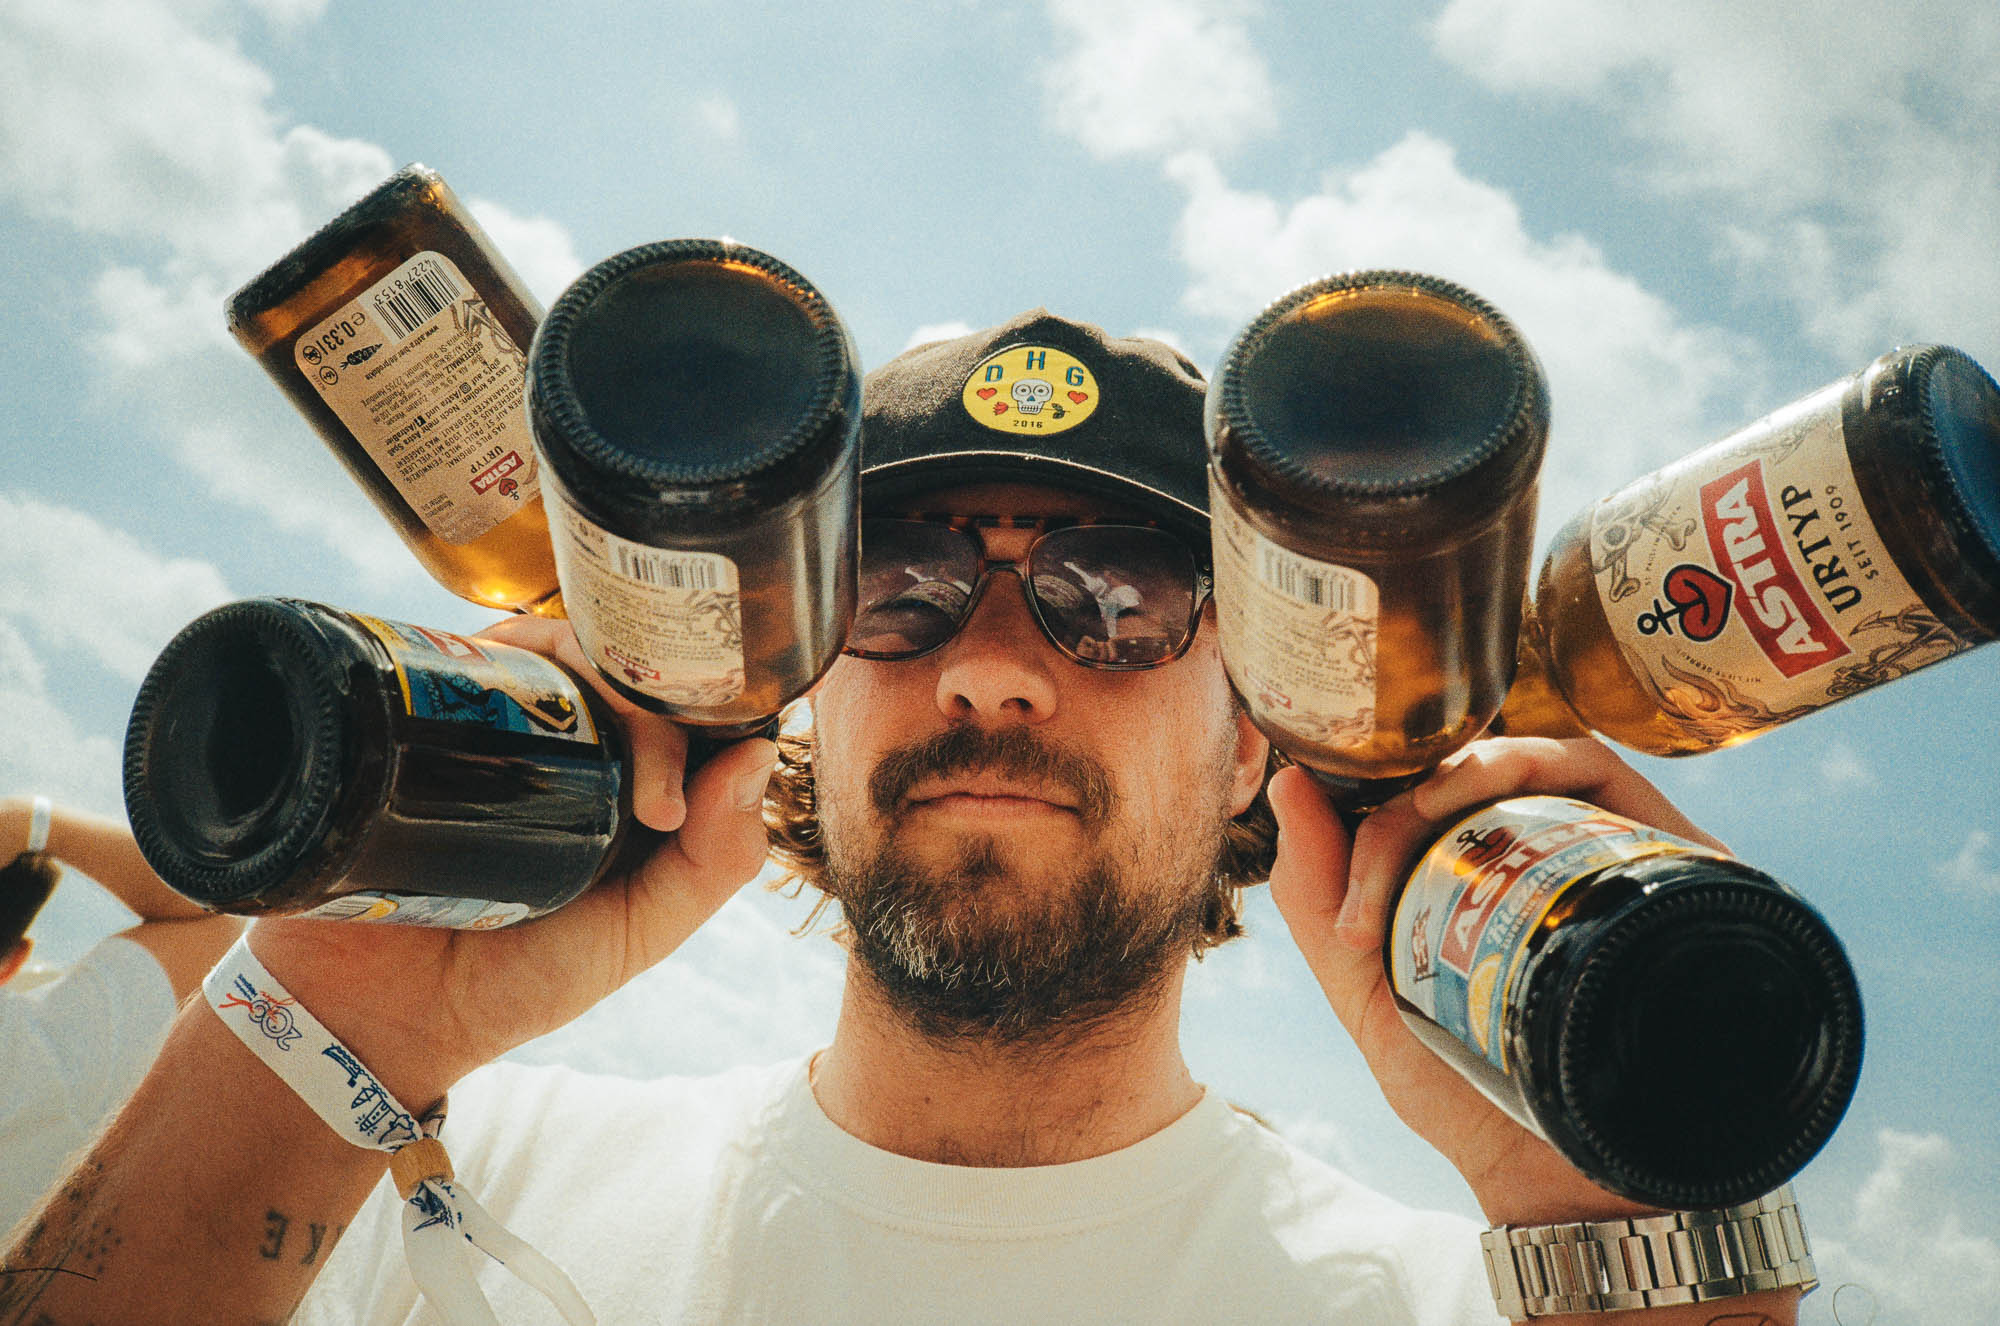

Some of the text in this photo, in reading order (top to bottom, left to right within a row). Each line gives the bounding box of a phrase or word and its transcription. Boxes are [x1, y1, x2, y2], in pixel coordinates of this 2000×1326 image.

[372, 257, 433, 305] 4227 8153
[470, 372, 484, 386] auf
[494, 363, 511, 378] Lass
[486, 375, 496, 384] es
[469, 382, 511, 416] CHARAKTER
[425, 405, 441, 419] und
[439, 403, 460, 421] Noch
[493, 408, 509, 422] AUF
[420, 417, 441, 434] mehr
[461, 418, 480, 434] SEIT
[1013, 419, 1042, 428] 2016
[402, 430, 422, 447] Astra
[423, 434, 440, 449] WAS
[443, 430, 463, 447] 1909
[444, 421, 507, 469] DAS PILS ORIGINAL
[431, 443, 445, 456] MIT
[415, 451, 433, 467] VIEL
[467, 444, 504, 474] URTYP
[398, 460, 418, 478] LIEBE
[474, 455, 519, 490] ASTRA
[1825, 485, 1879, 580] SEIT 1909
[1781, 485, 1862, 614] URTYP
[1715, 477, 1828, 654] ASTRA
